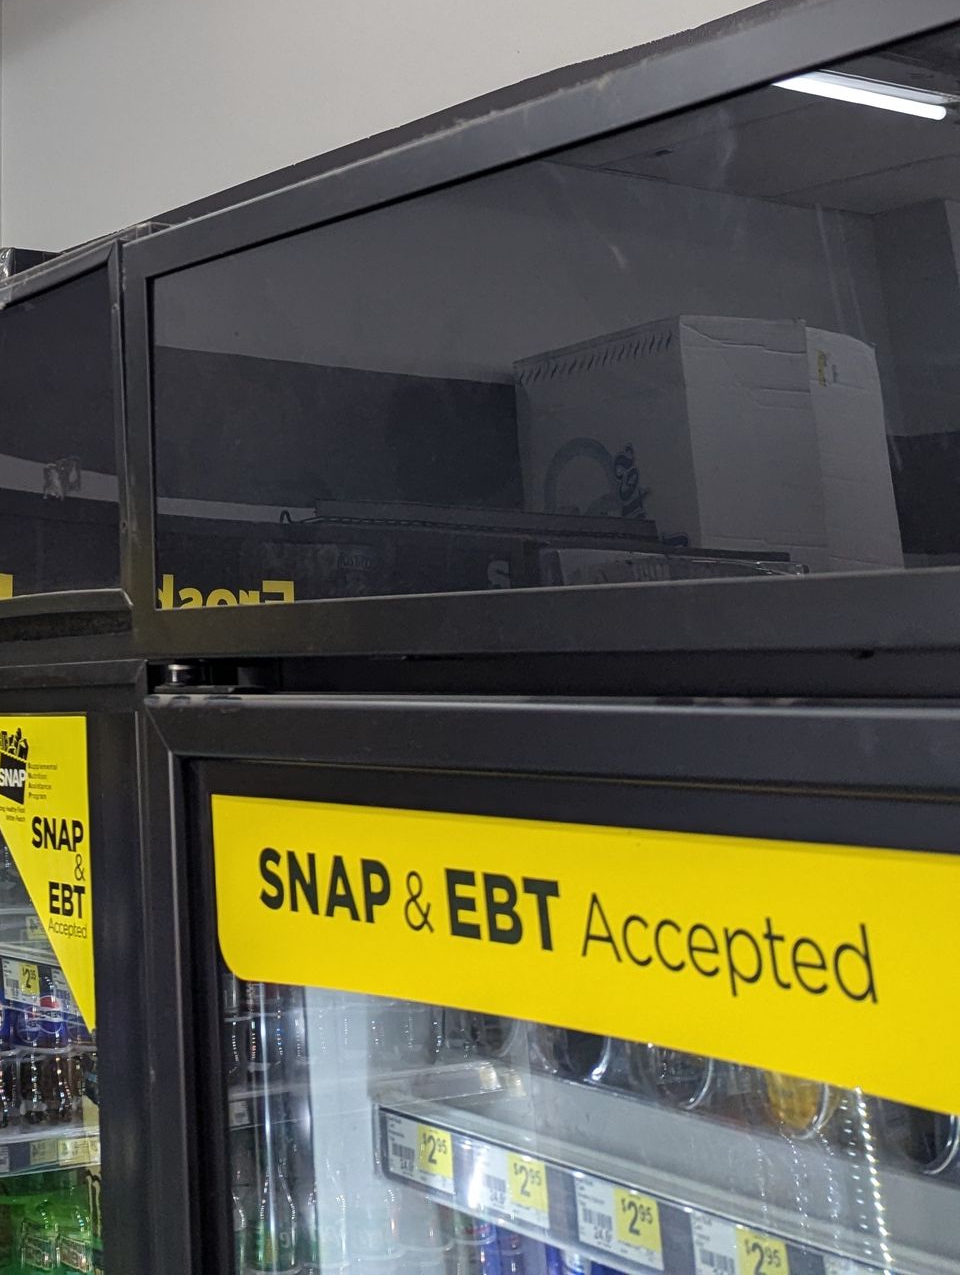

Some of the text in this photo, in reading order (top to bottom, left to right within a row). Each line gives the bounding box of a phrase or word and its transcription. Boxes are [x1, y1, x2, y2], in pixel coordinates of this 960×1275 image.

[31, 816, 84, 852] SNAP
[74, 854, 86, 881] &
[48, 881, 86, 918] EBT
[48, 917, 88, 939] Accepted
[258, 847, 878, 1005] SNAP & EBT Accepted
